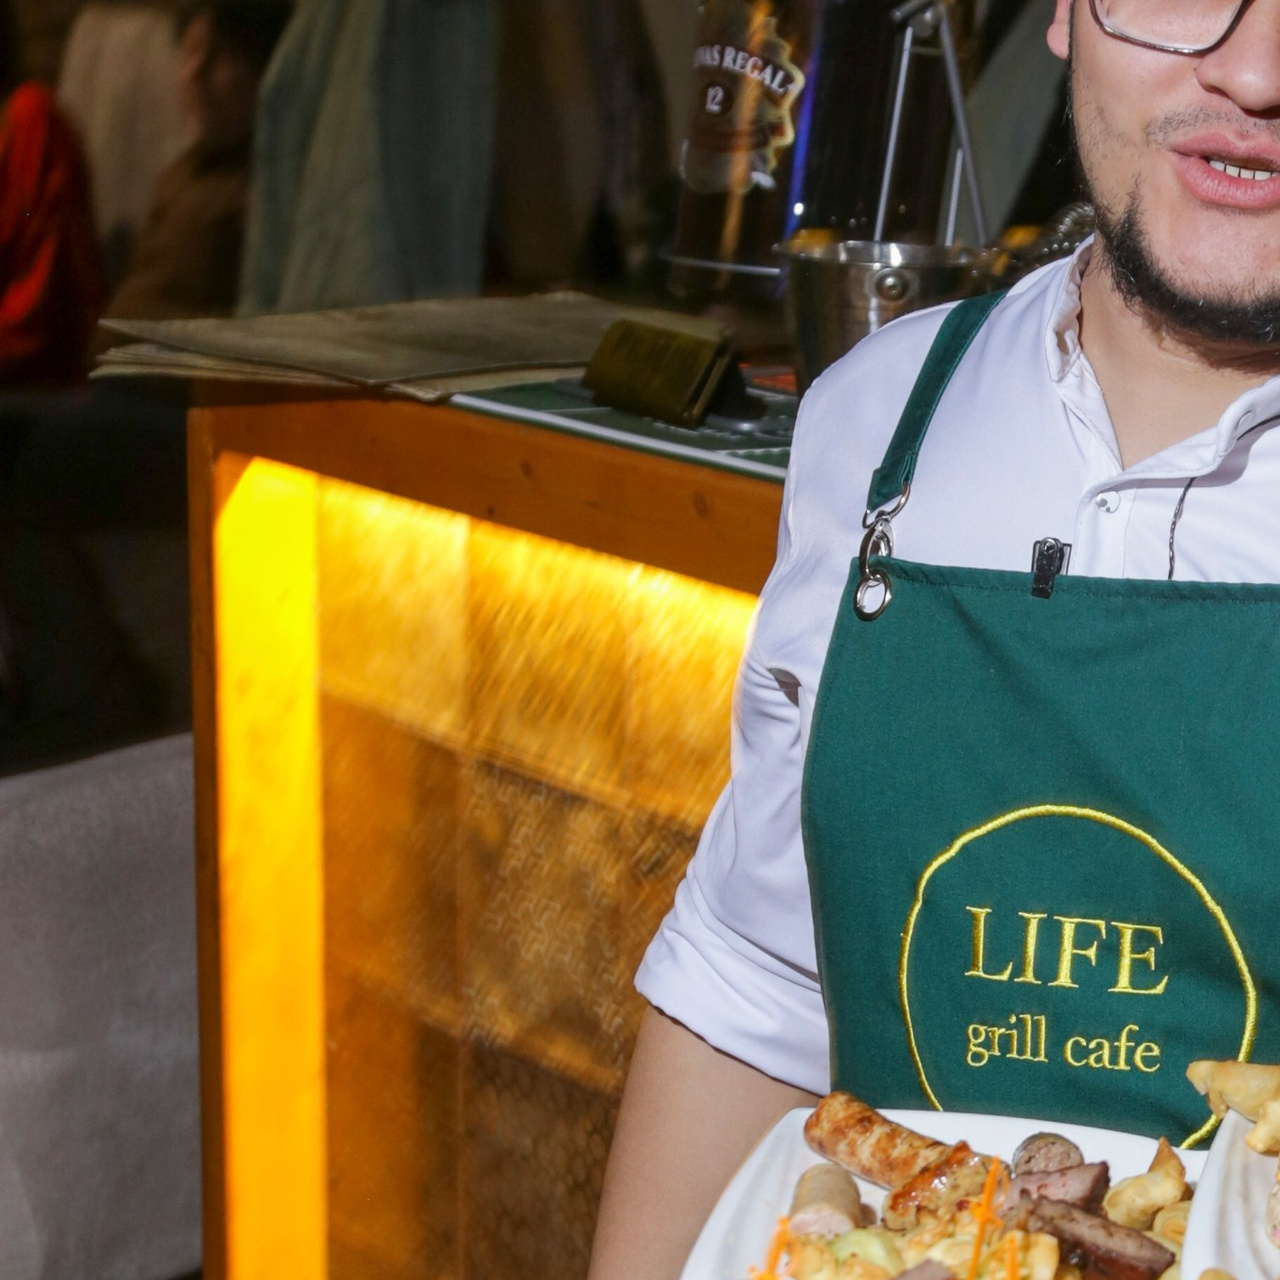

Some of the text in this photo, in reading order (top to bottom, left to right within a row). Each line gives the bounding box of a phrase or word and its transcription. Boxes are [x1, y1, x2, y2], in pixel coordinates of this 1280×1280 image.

[722, 45, 788, 95] REGAL
[705, 85, 724, 113] 12
[965, 906, 1169, 995] LIFE
[965, 1013, 1161, 1073] grill cafe
